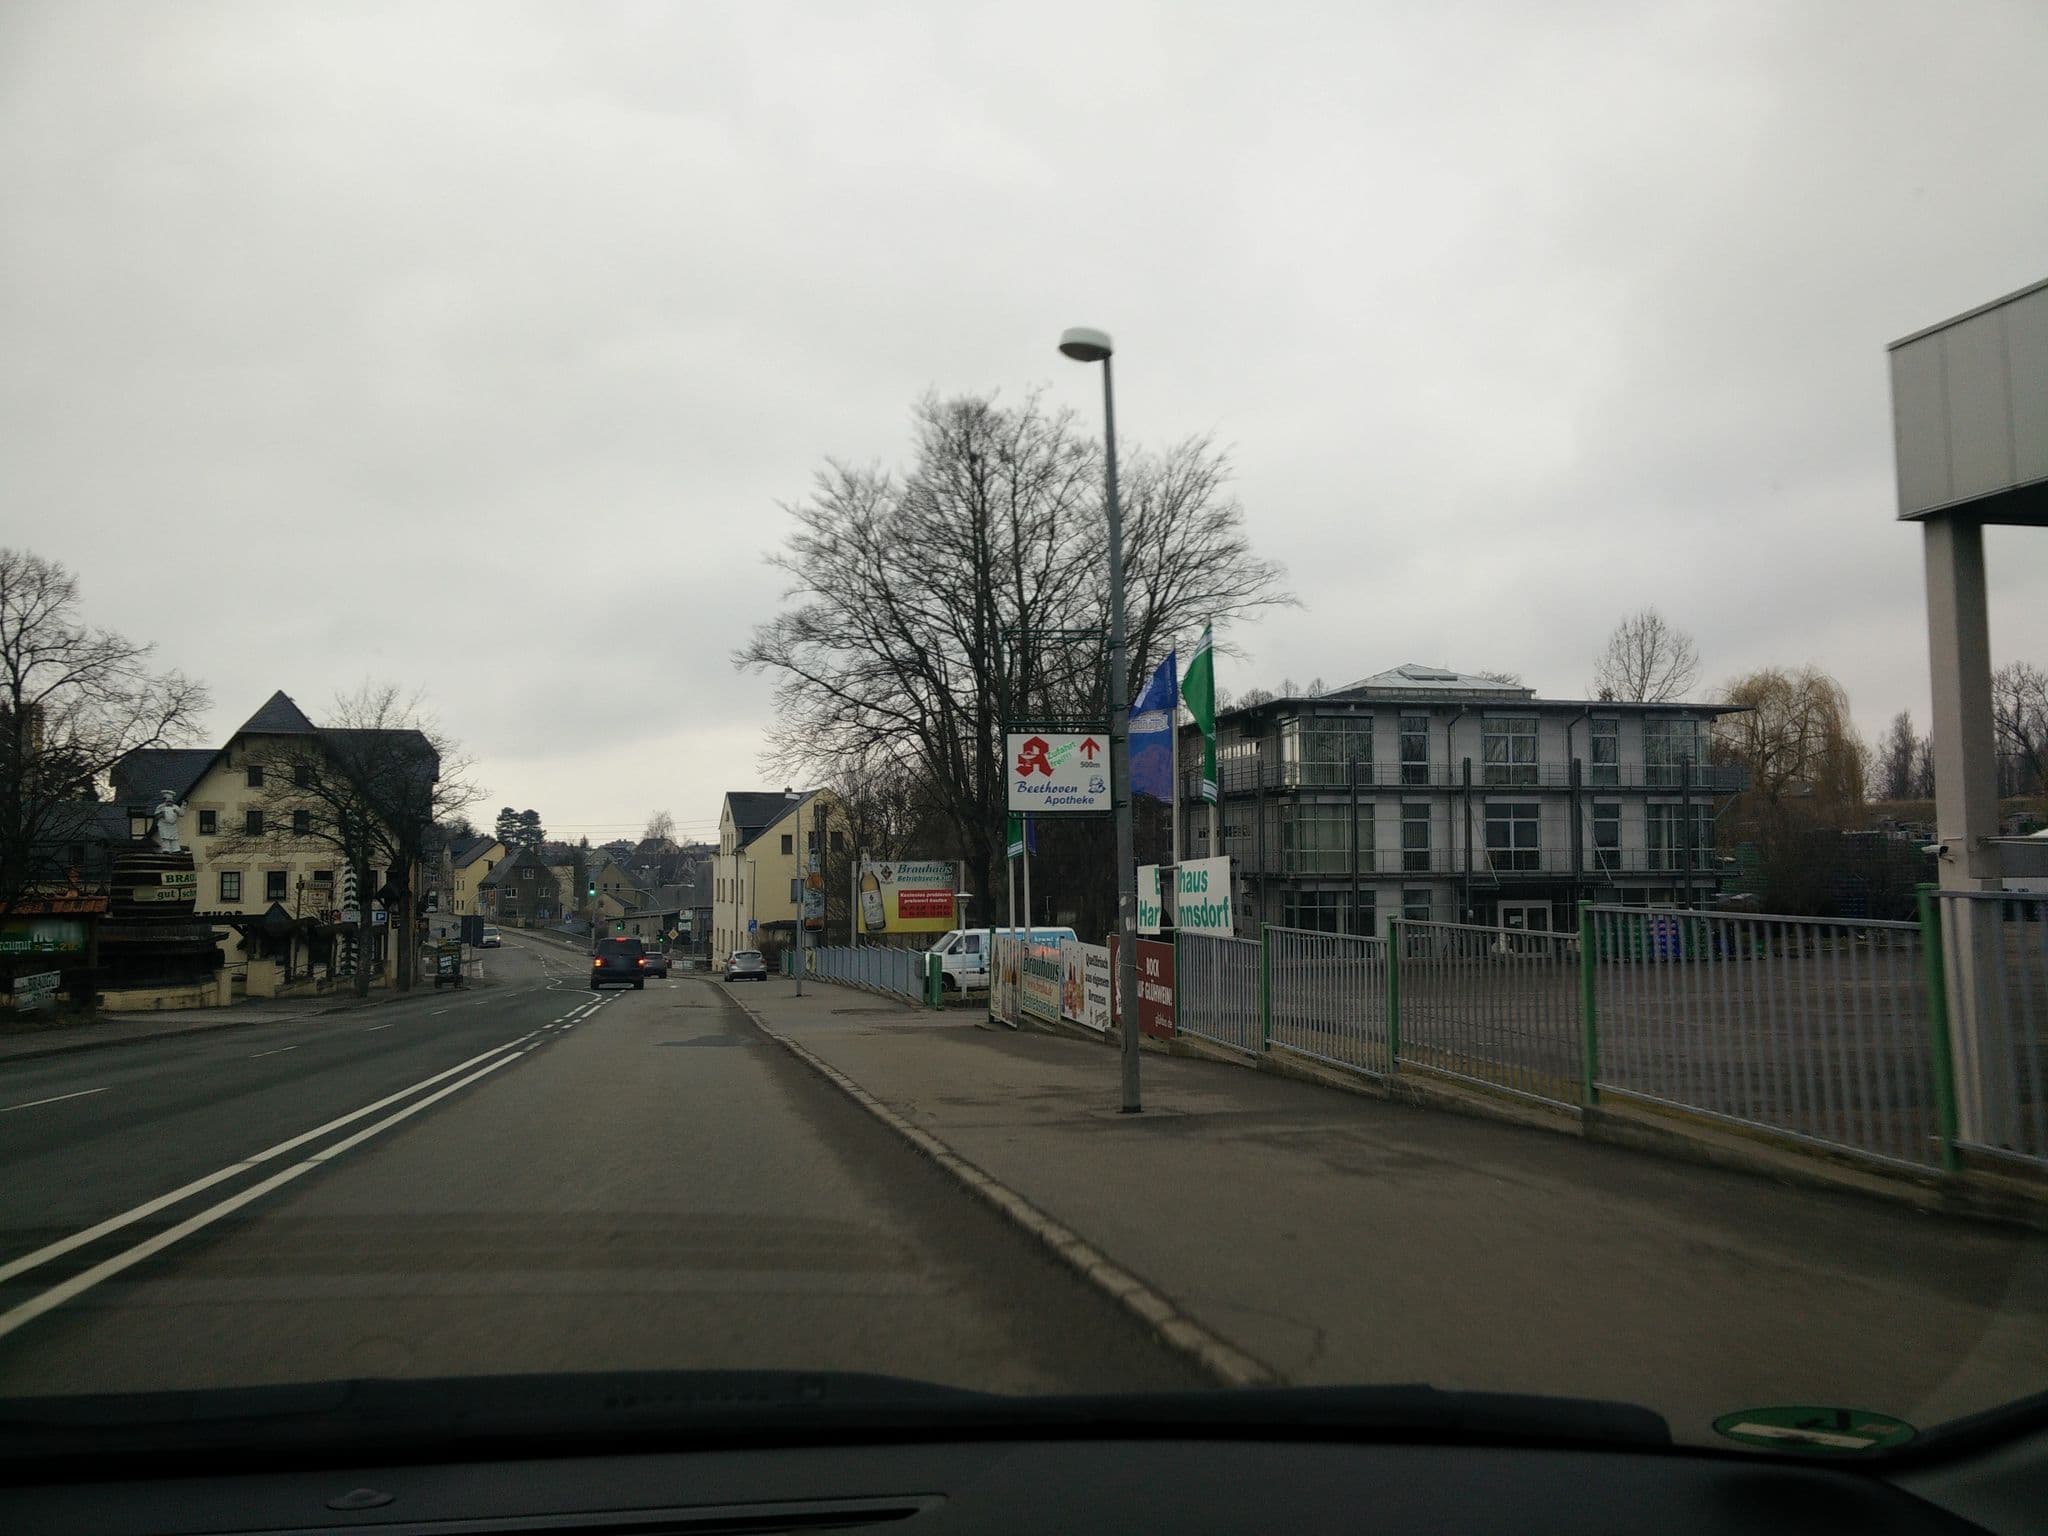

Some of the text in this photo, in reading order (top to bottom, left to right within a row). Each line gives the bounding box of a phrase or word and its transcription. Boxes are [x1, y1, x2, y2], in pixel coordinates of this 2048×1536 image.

[1080, 761, 1101, 769] 500m
[1014, 781, 1078, 793] Beethoven
[1044, 795, 1095, 807] Apotheke
[897, 864, 953, 874] Brauhaus
[1023, 947, 1060, 983] Brauhaus
